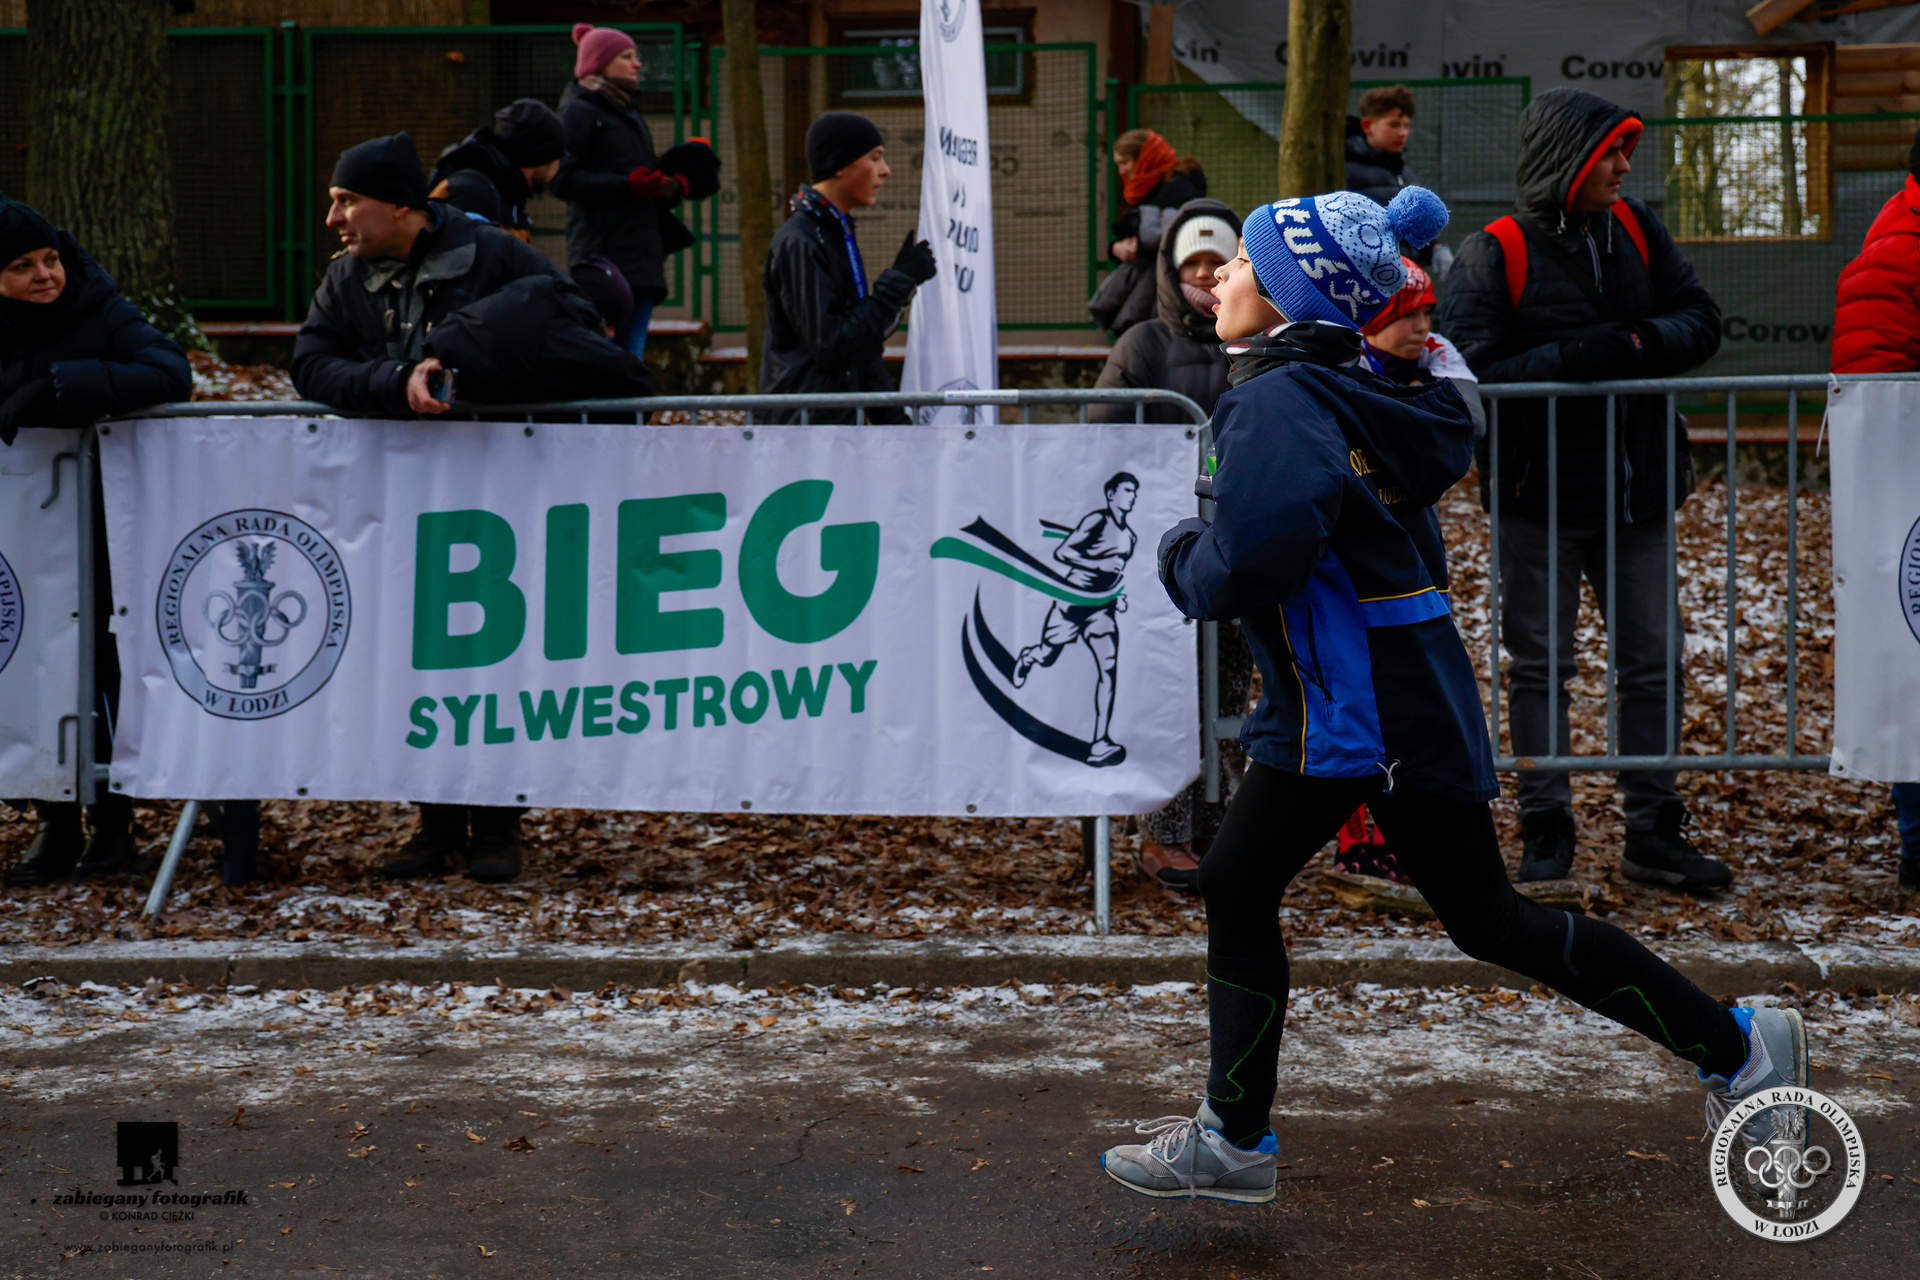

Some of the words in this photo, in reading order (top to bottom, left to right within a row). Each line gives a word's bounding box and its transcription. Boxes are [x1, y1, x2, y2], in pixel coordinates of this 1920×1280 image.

[1561, 56, 1664, 79] Corov
[1722, 317, 1831, 342] Corov
[165, 525, 228, 645] REGIONALNA
[235, 517, 290, 536] RADA
[297, 532, 345, 648] OLIMPIJSKA
[412, 479, 880, 670] BIEG
[206, 690, 222, 707] W
[405, 659, 879, 749] SYLWESTROWY
